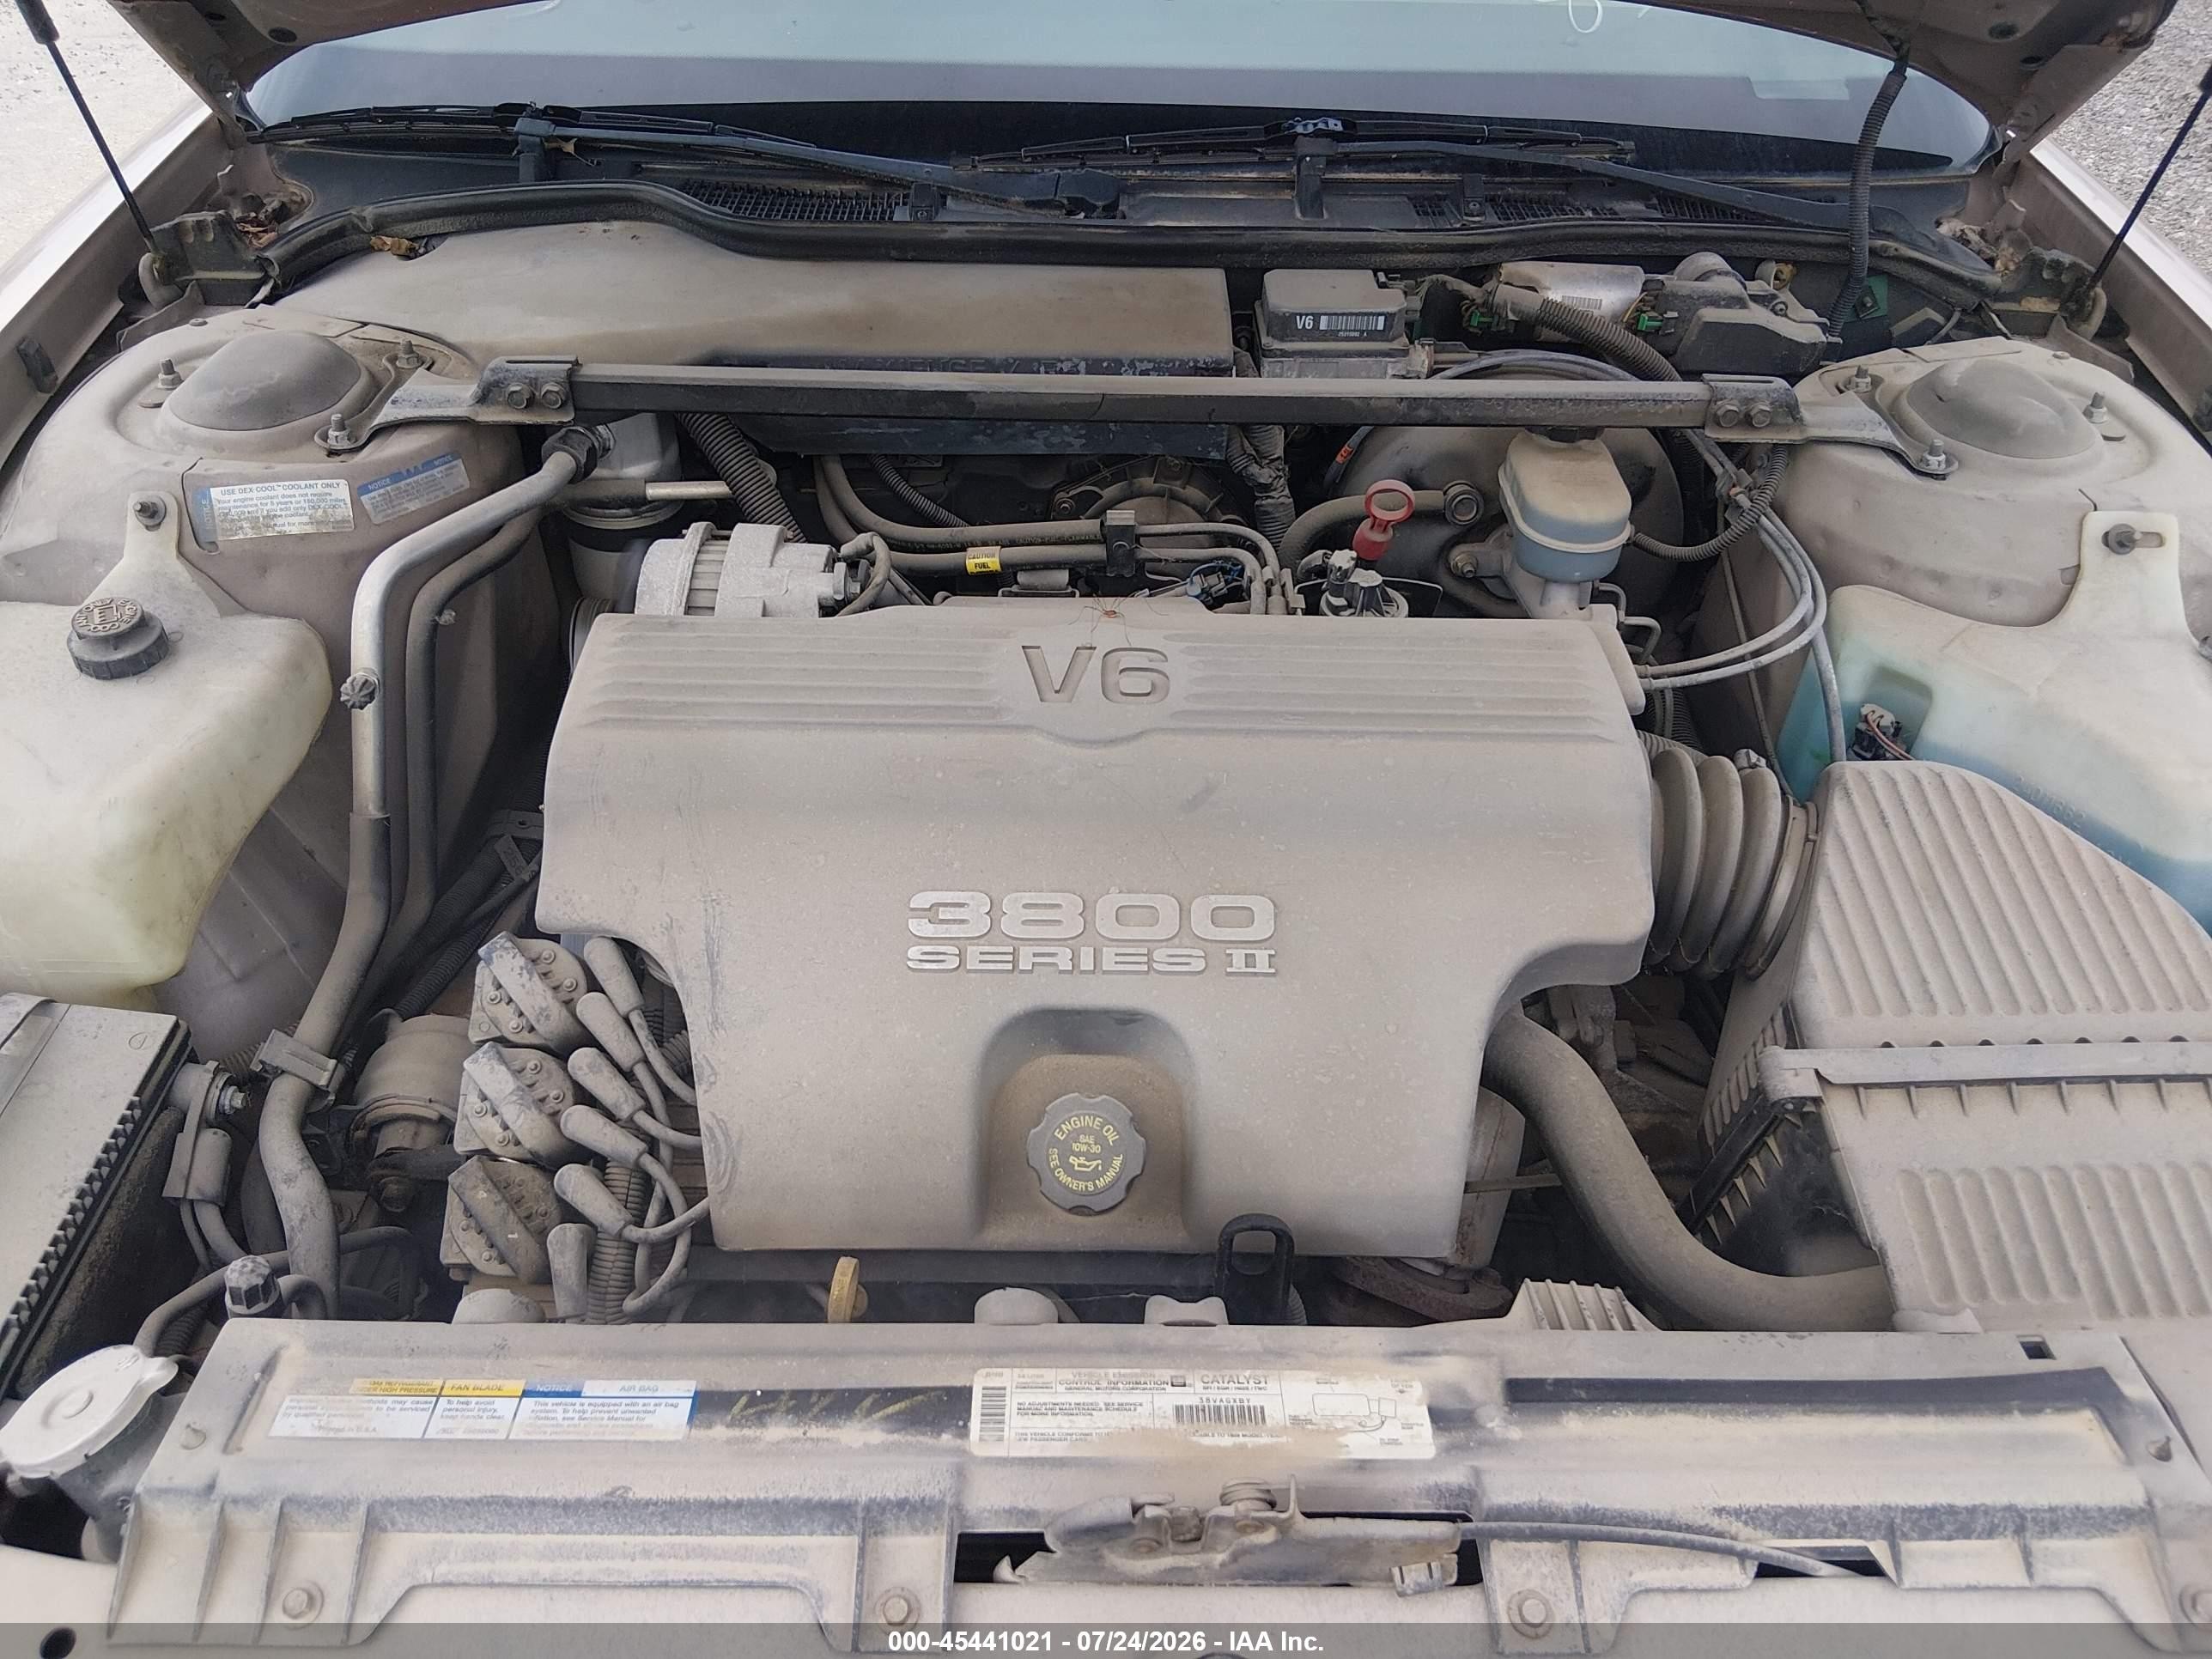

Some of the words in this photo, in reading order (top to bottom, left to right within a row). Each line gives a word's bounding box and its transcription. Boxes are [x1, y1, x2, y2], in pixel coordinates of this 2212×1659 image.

[1296, 315, 1314, 329] V6
[282, 483, 319, 491] COOLANT
[368, 477, 392, 490] NOTICE
[1022, 646, 1170, 704] V6
[908, 891, 1277, 941] 3800
[907, 946, 1206, 975] SERIES
[1224, 948, 1277, 975] II
[1054, 1115, 1103, 1141] ENGINE
[1102, 1125, 1120, 1146] OIL
[1079, 1134, 1096, 1144] SAE
[1072, 1143, 1102, 1153] 10W-30
[1048, 1148, 1060, 1169] SEE
[1054, 1167, 1095, 1192] OWNER'S
[1095, 1153, 1123, 1189] MANUAL
[1200, 1374, 1268, 1385] CATALYST
